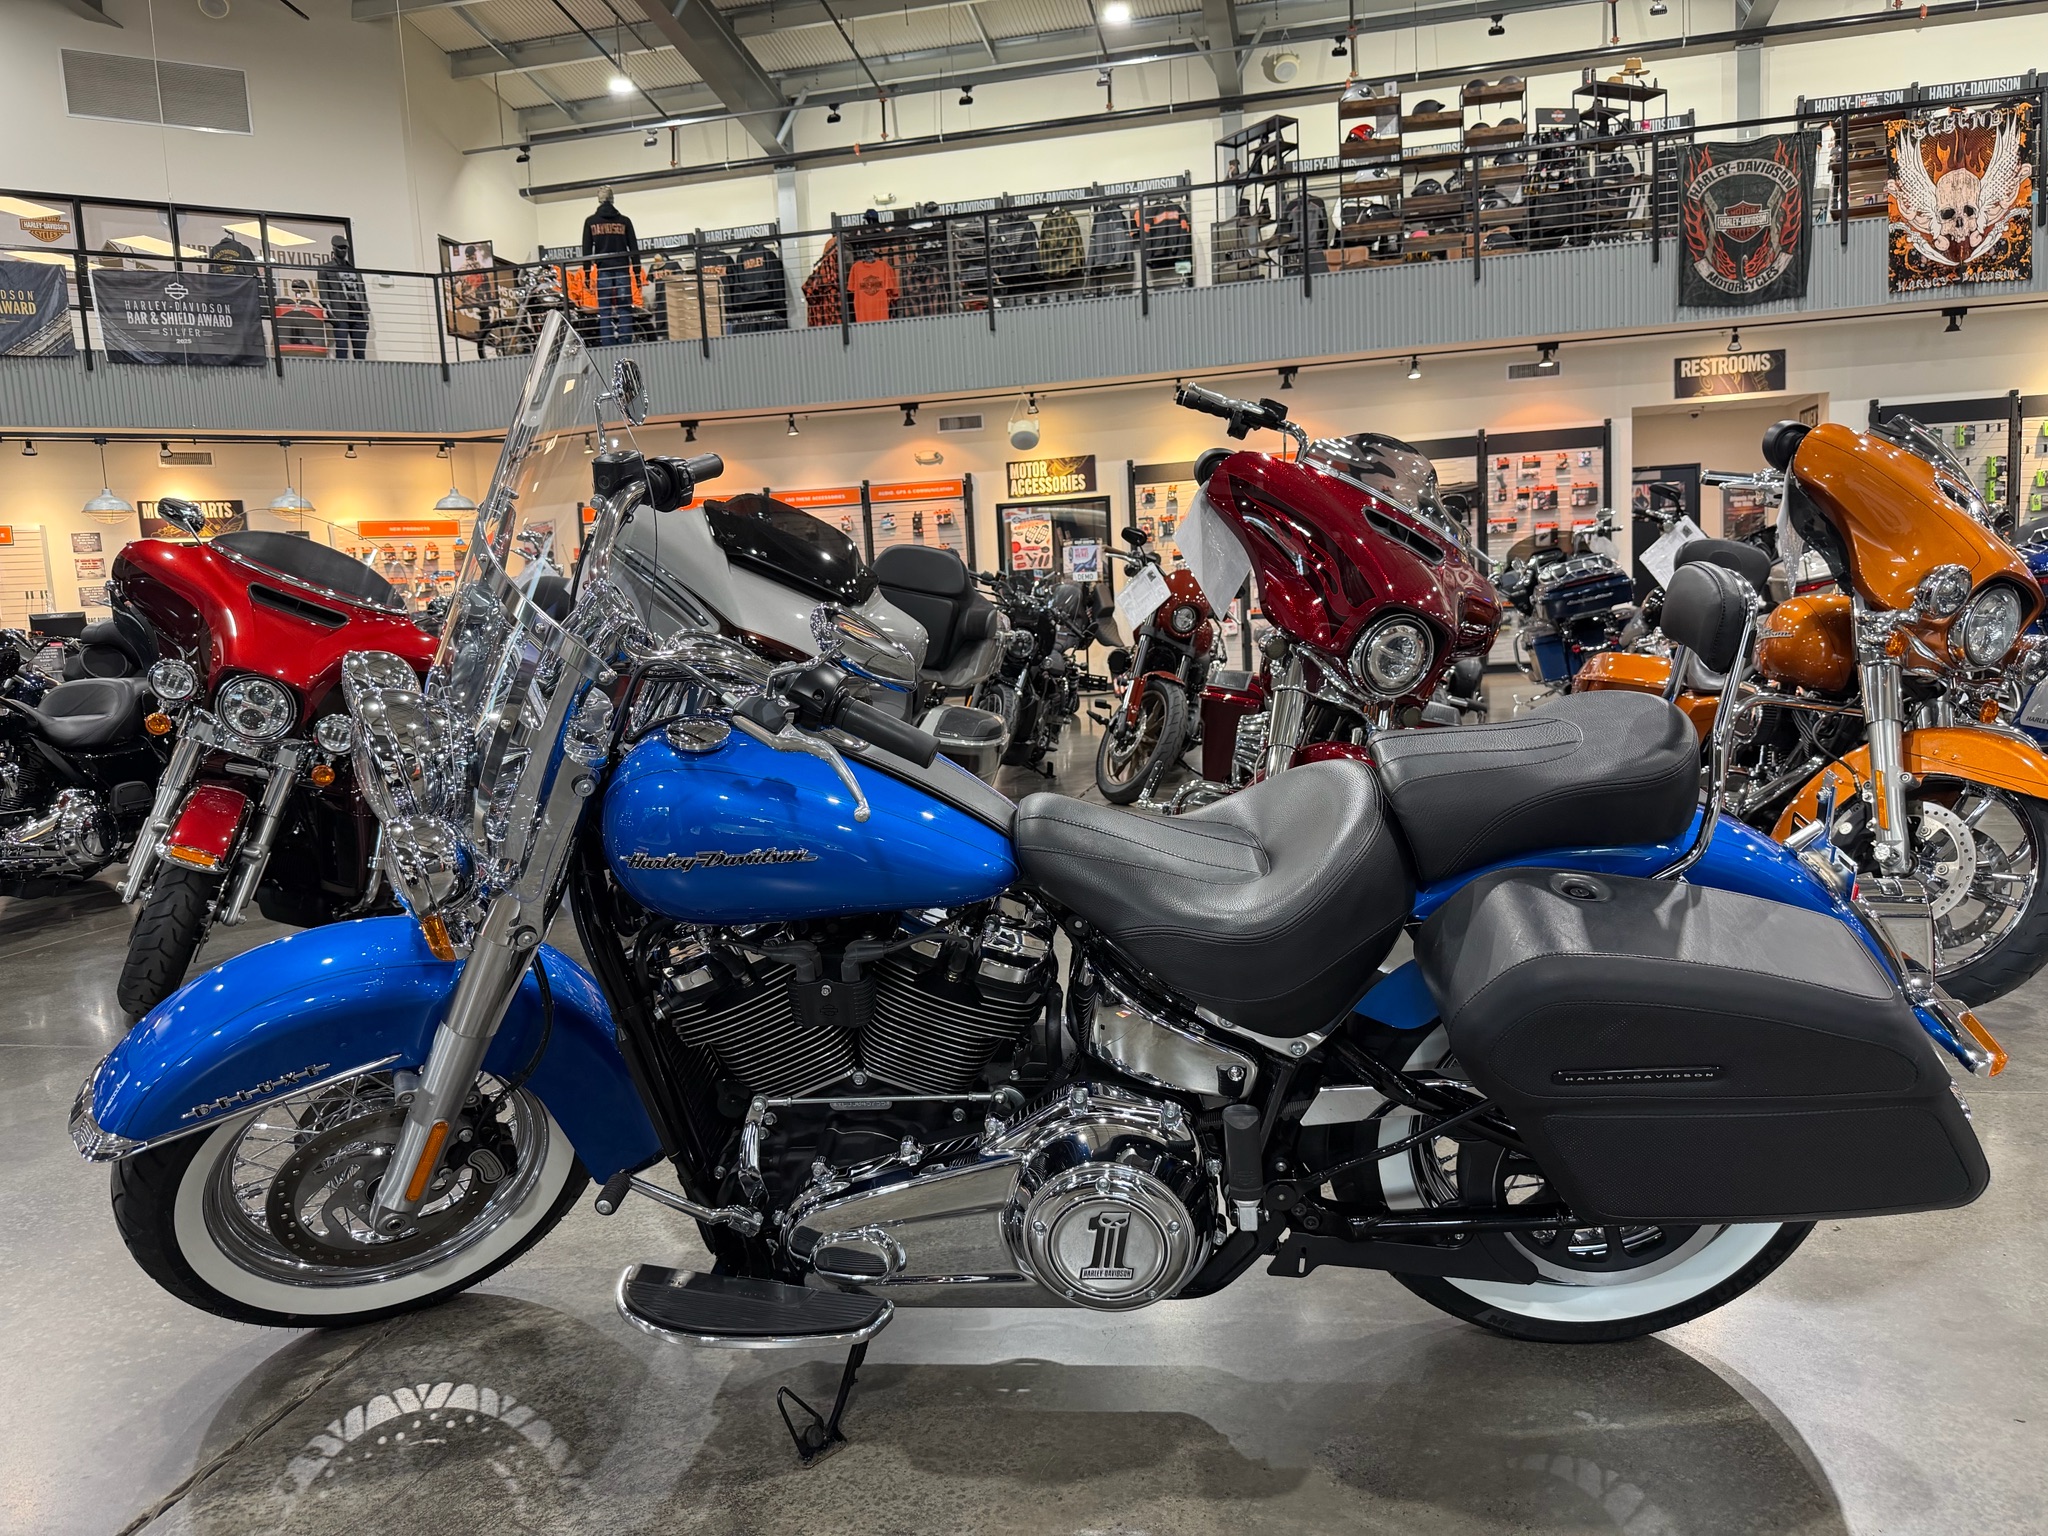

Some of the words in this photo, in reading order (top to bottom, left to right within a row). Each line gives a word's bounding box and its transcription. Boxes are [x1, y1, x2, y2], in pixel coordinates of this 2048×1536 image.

[1929, 77, 2021, 100] HARLEY-DAVIDSON
[1104, 177, 1178, 196] HARLEY-DAVIDSON
[1690, 160, 1796, 199] HARLEY-DAVIDSON
[1014, 189, 1086, 207] HARLEY-DAVIDSON
[23, 221, 68, 231] HARLEY-DAVIDSON
[1719, 214, 1768, 226] HARLEY-DAVIDSON
[704, 224, 770, 243] HARLEY-DAVIDSON
[1706, 265, 1780, 292] MOTORCYCLES
[124, 300, 232, 314] HARLEY-DAVIDSON
[126, 311, 149, 325] BAR
[150, 312, 160, 325] &
[160, 312, 196, 326] SHIELD
[197, 314, 233, 328] AWARD
[162, 328, 201, 337] SILVER
[1680, 353, 1771, 378] RESTROOMS
[1009, 461, 1048, 480] MOTOR
[1010, 473, 1087, 496] ACCESSORIES
[620, 847, 818, 873] Harley-Davidson
[1565, 1073, 1714, 1081] HARLEY-DAVIDSON
[186, 1063, 325, 1118] DELUXE
[1083, 1269, 1131, 1279] HARLEY-DAVIDSON
